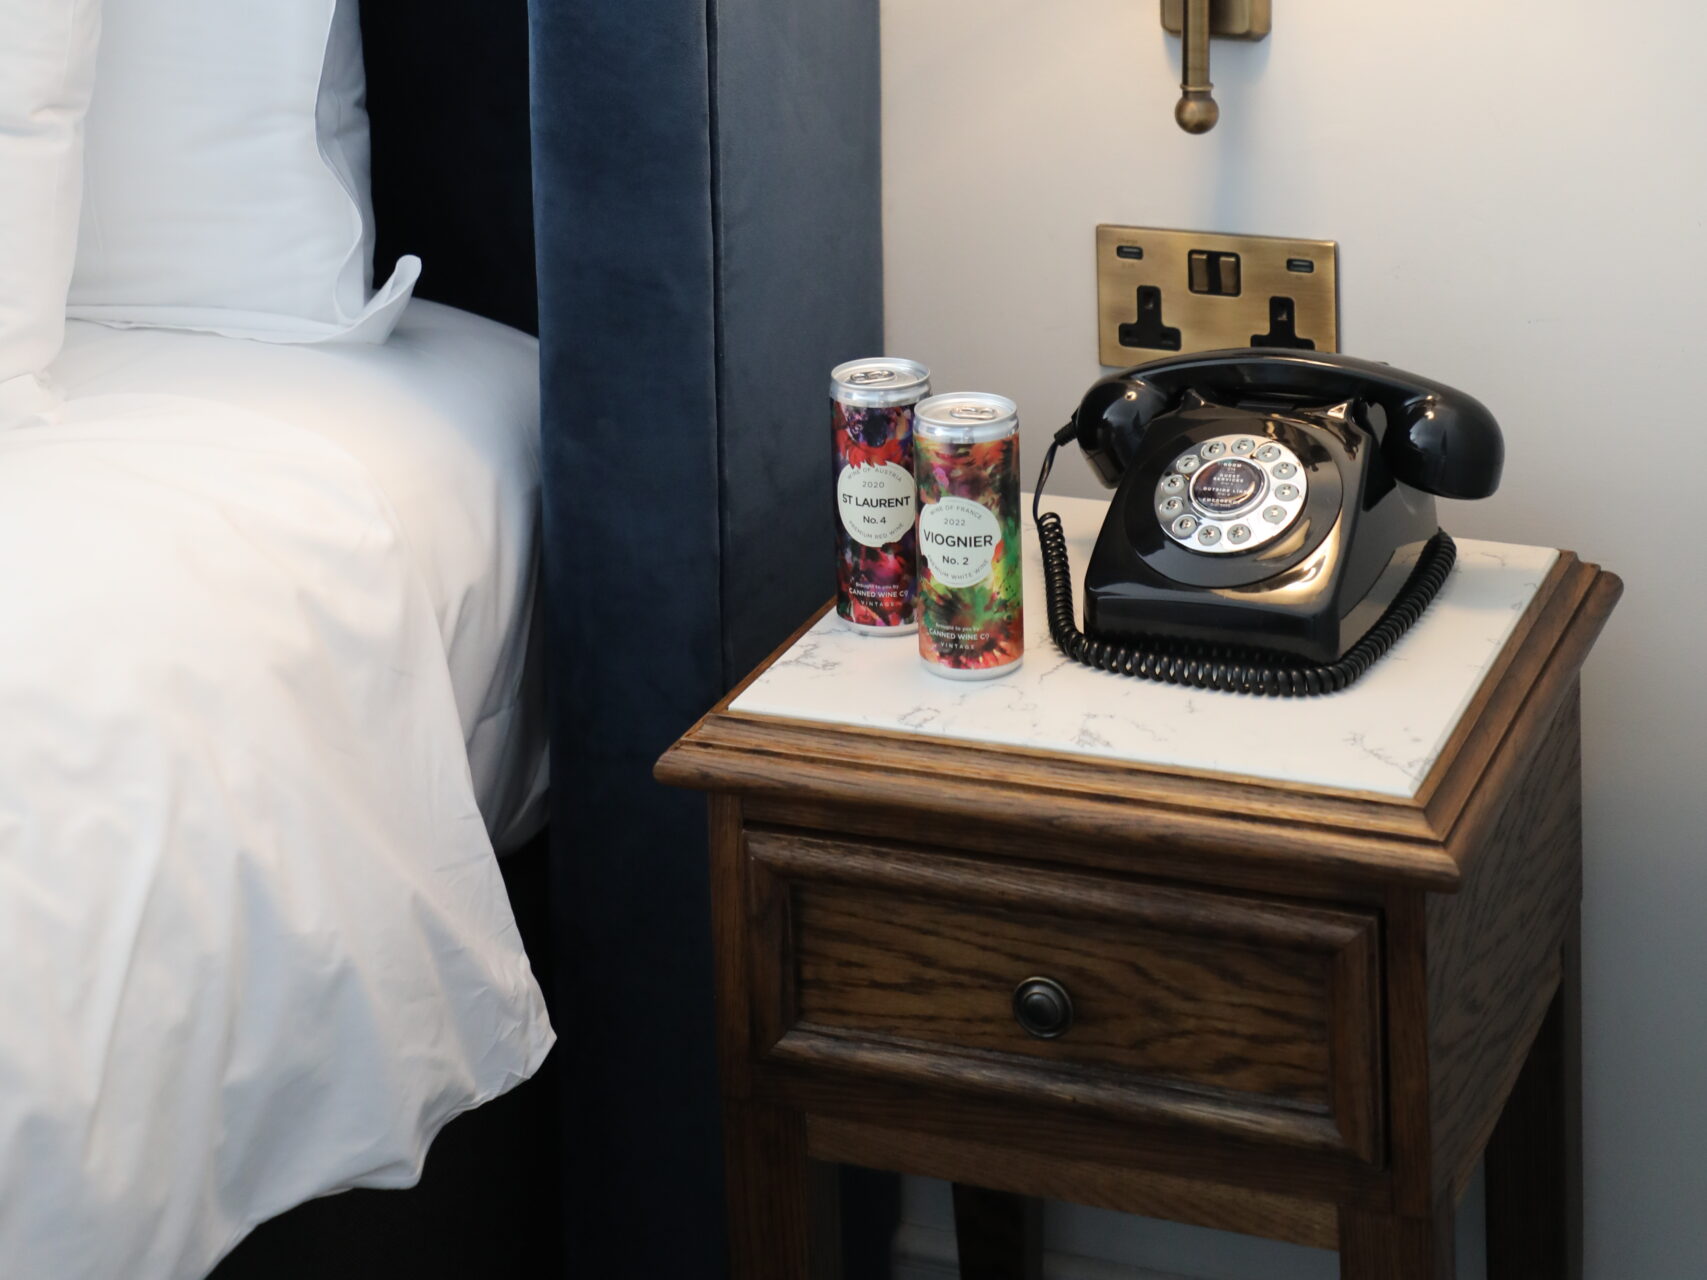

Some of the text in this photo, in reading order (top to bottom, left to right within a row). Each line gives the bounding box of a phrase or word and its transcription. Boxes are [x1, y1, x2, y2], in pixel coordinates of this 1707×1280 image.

[874, 467, 903, 483] AUSTRIA
[842, 493, 911, 508] ST LAURENT
[956, 504, 982, 520] FRANCE
[863, 515, 887, 524] No. 4
[944, 518, 966, 526] 2022
[848, 520, 873, 538] PREMIUM
[888, 522, 904, 535] WINE
[923, 528, 994, 548] VIOGNIER
[942, 555, 969, 565] No. 2
[951, 573, 973, 581] WHITE
[849, 587, 876, 597] CANNED
[860, 599, 895, 608] VINTAGE
[929, 627, 956, 640] CANNED
[940, 641, 975, 650] VINTAGE
